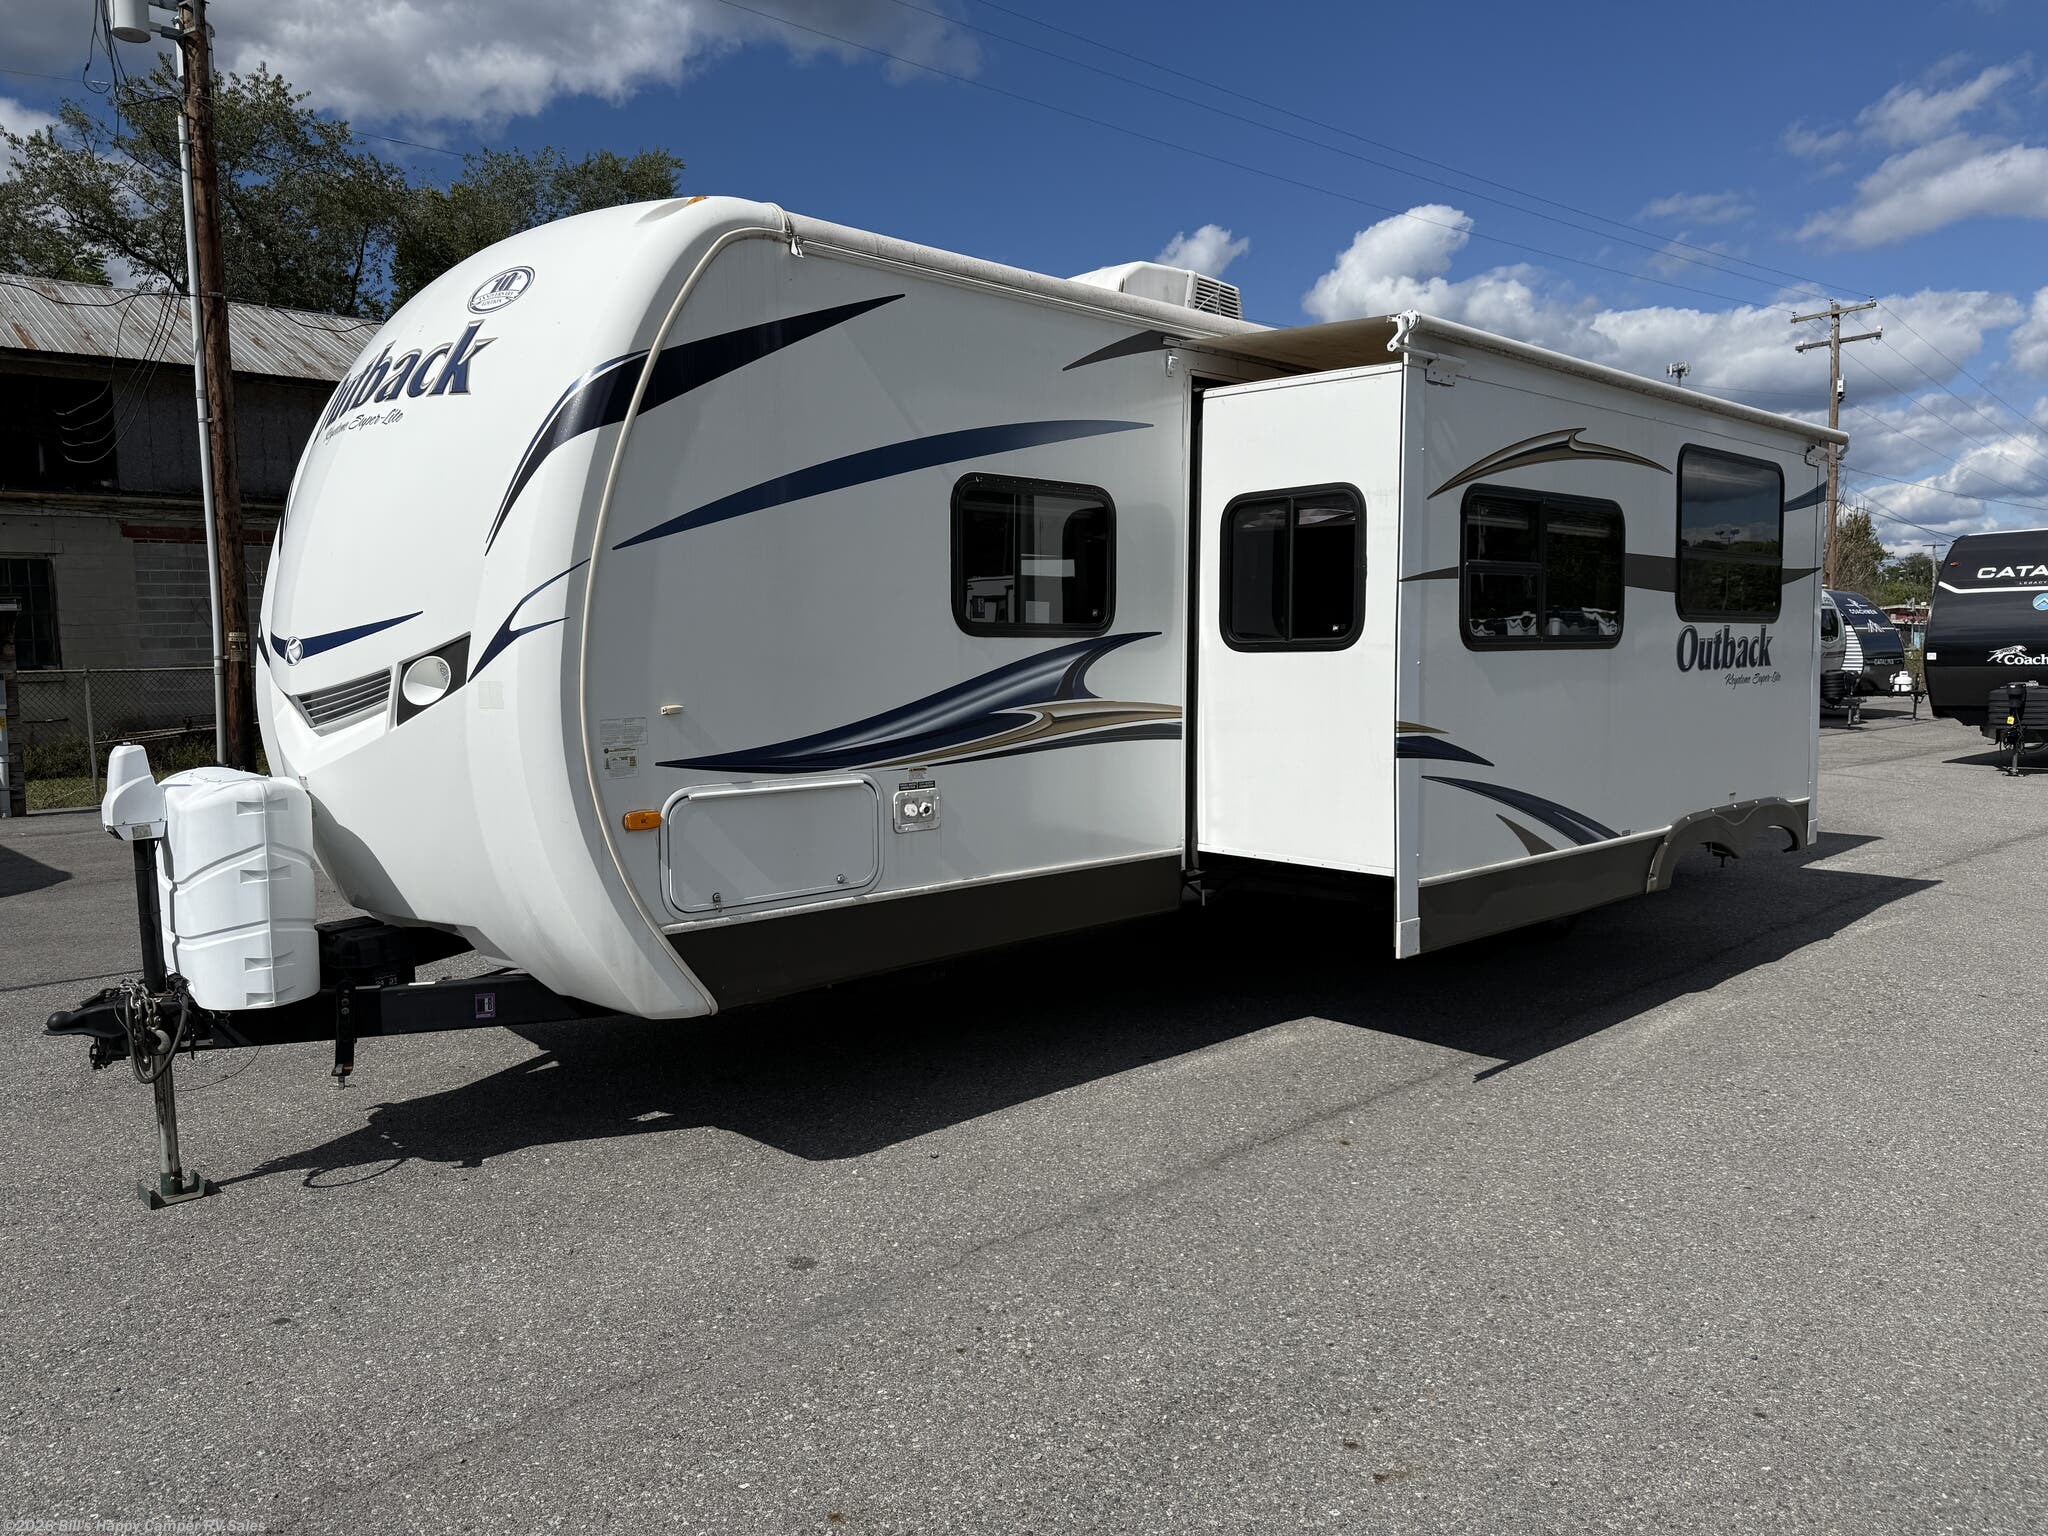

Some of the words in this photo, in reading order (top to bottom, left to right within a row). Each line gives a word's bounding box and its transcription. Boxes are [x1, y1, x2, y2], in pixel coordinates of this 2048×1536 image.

[1977, 564, 2048, 579] CATA
[1676, 624, 1774, 672] Outback
[2003, 653, 2048, 665] Coach
